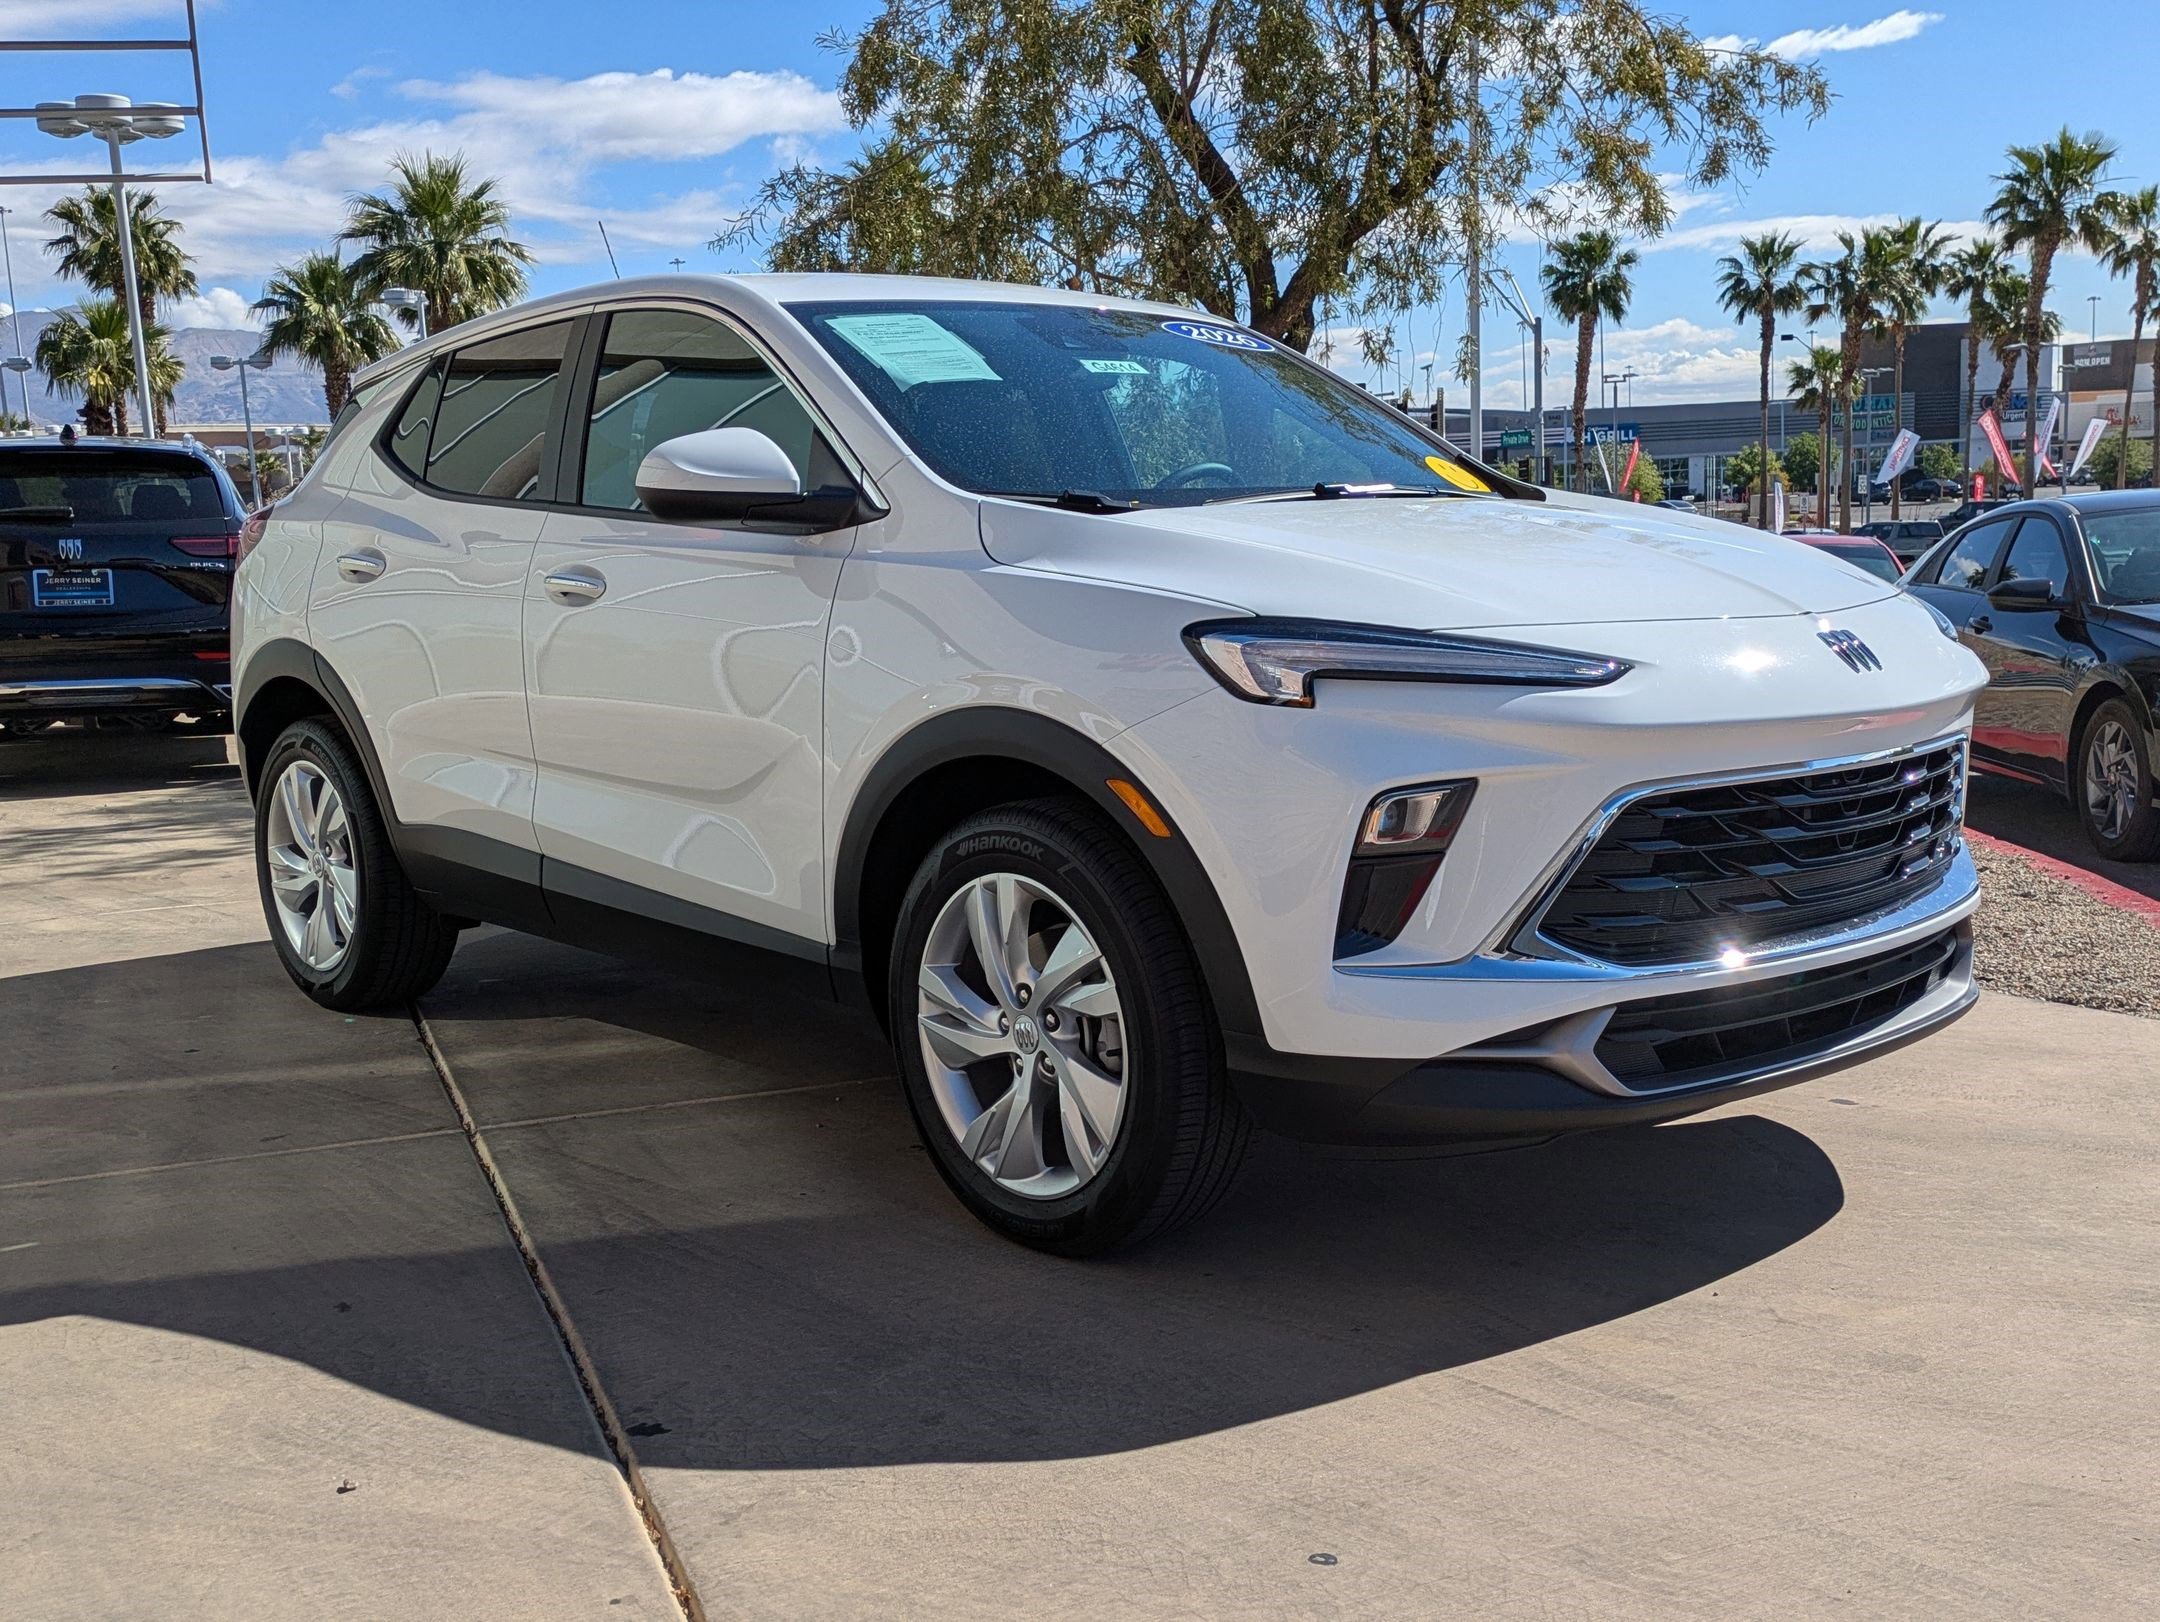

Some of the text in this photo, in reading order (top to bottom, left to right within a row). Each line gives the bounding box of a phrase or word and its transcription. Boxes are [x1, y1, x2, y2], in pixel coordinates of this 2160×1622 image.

[1180, 325, 1258, 348] 2026
[1092, 361, 1139, 372] G4614
[2091, 356, 2110, 366] OPEN
[2002, 411, 2025, 421] Urgent
[1503, 434, 1529, 445] Private Drive
[1598, 429, 1636, 443] GRILL
